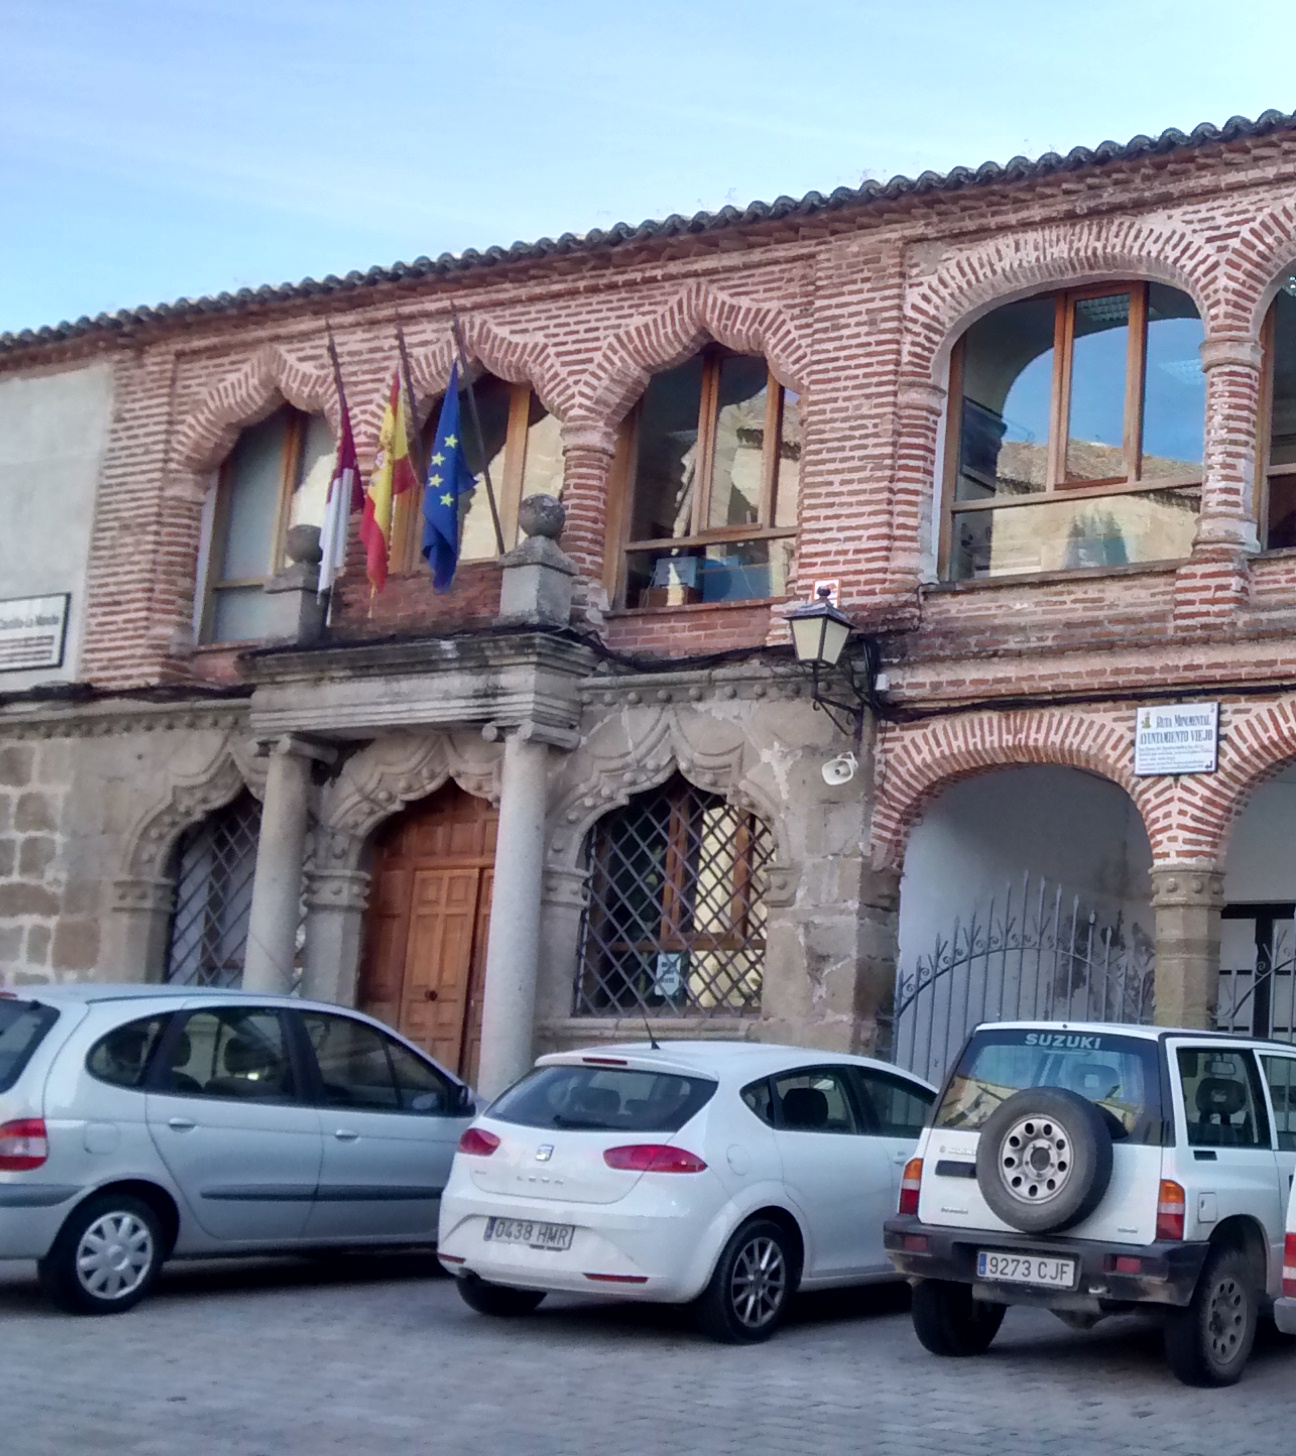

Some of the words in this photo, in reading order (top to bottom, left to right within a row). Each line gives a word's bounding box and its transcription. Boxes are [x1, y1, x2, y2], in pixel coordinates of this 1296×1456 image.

[1139, 730, 1189, 745] AYUNTAMIENTO
[1190, 729, 1213, 742] VIEJO
[1025, 1033, 1101, 1050] SUZUKI
[495, 1221, 533, 1241] 0438
[536, 1224, 569, 1246] HMR
[989, 1256, 1032, 1277] 9273
[1037, 1261, 1070, 1281] CJF
